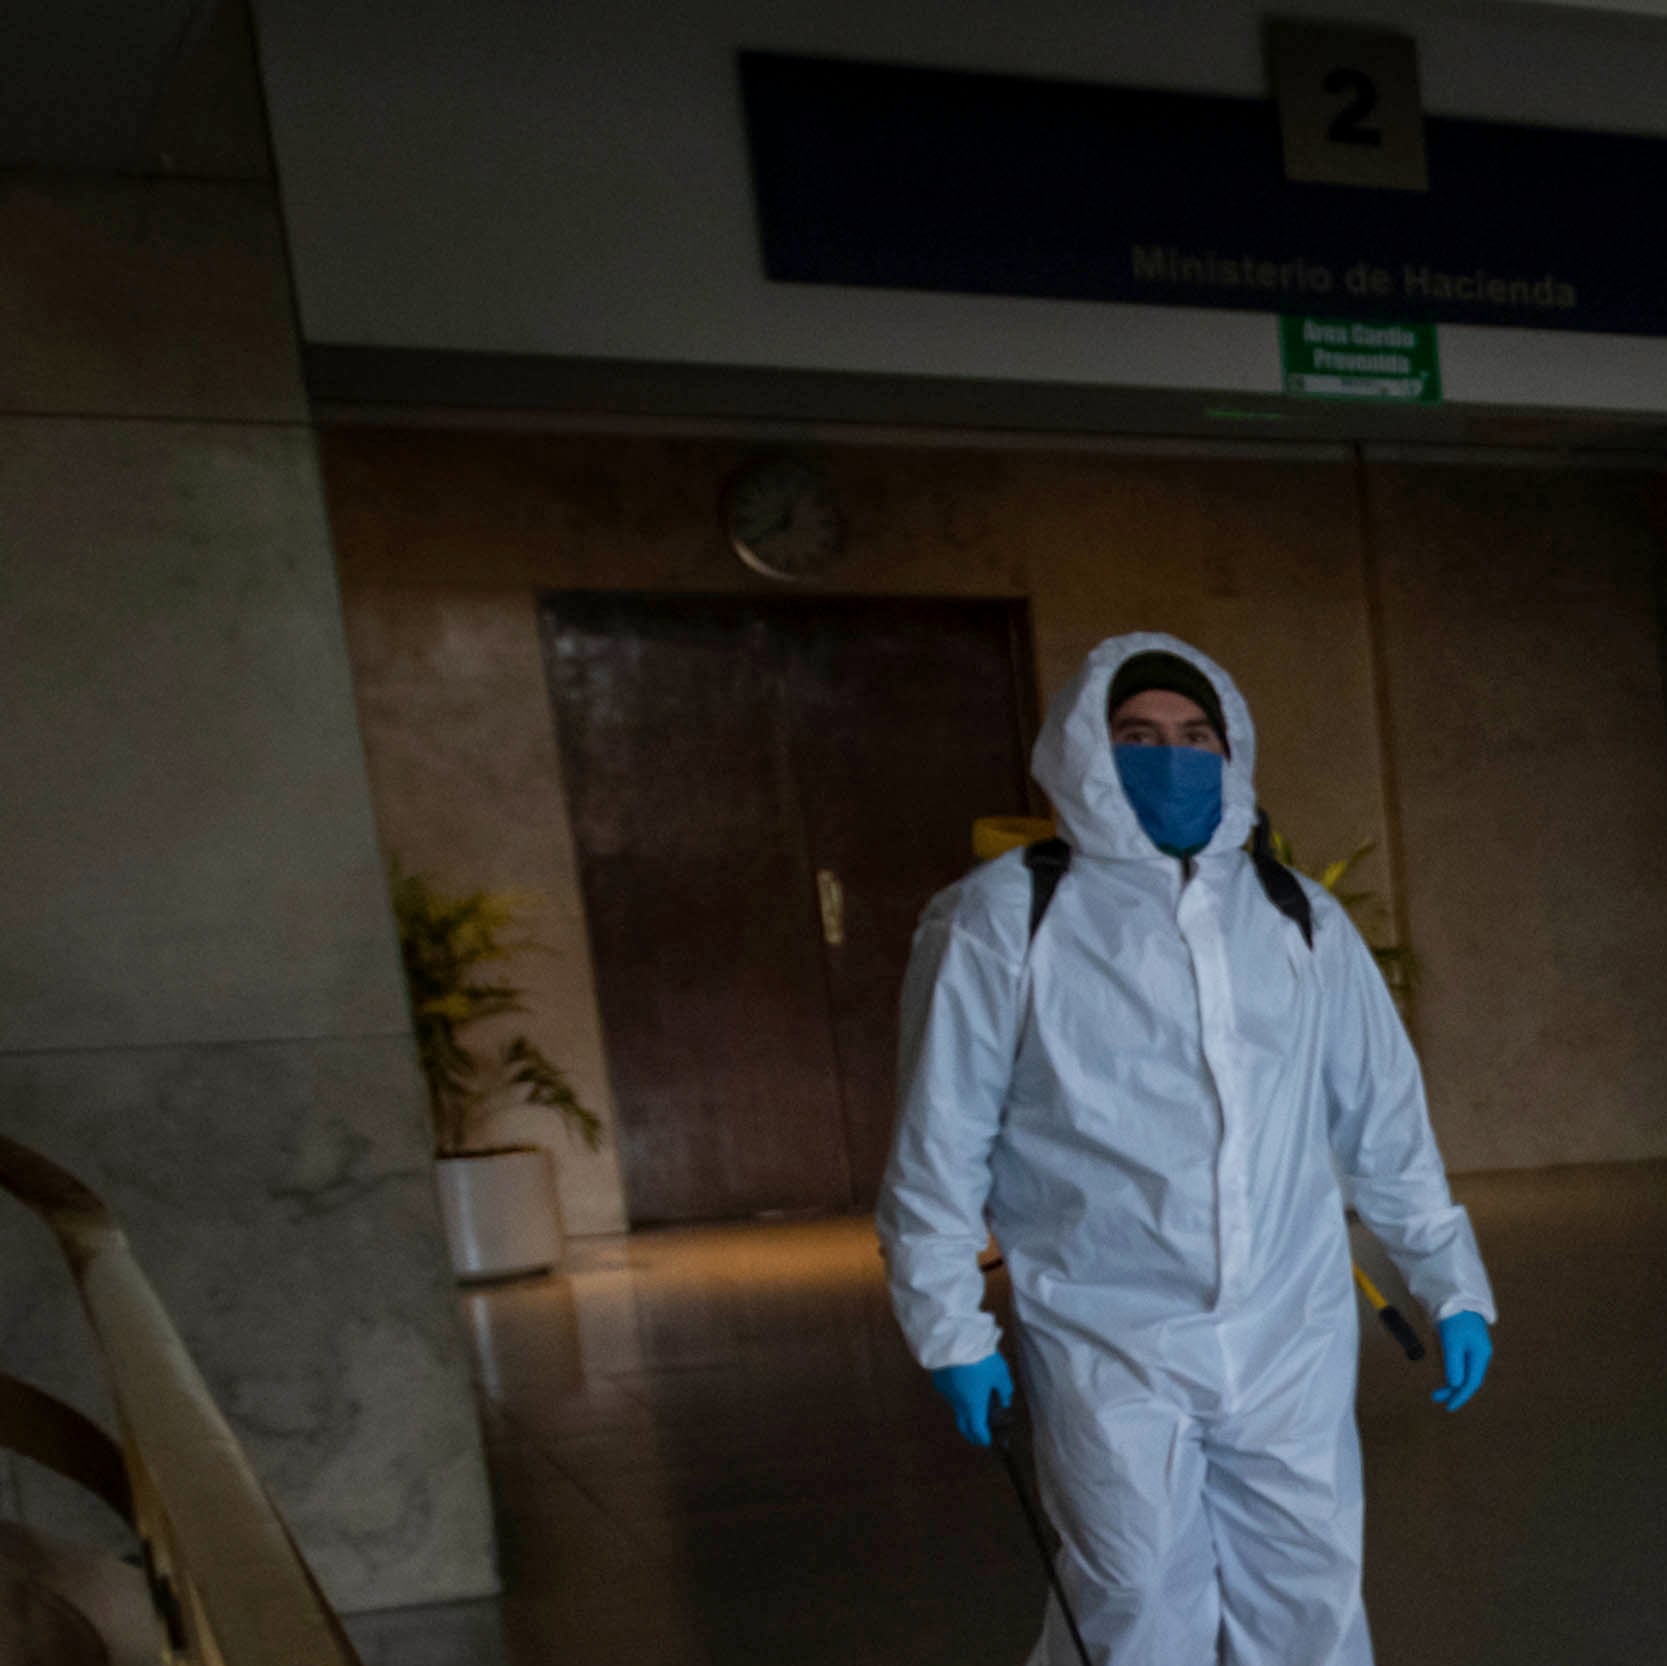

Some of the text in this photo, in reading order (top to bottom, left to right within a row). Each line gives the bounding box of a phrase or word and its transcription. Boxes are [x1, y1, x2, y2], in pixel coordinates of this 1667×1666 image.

[1324, 68, 1381, 146] 2
[1130, 242, 1578, 309] Ministerio de Hacienda
